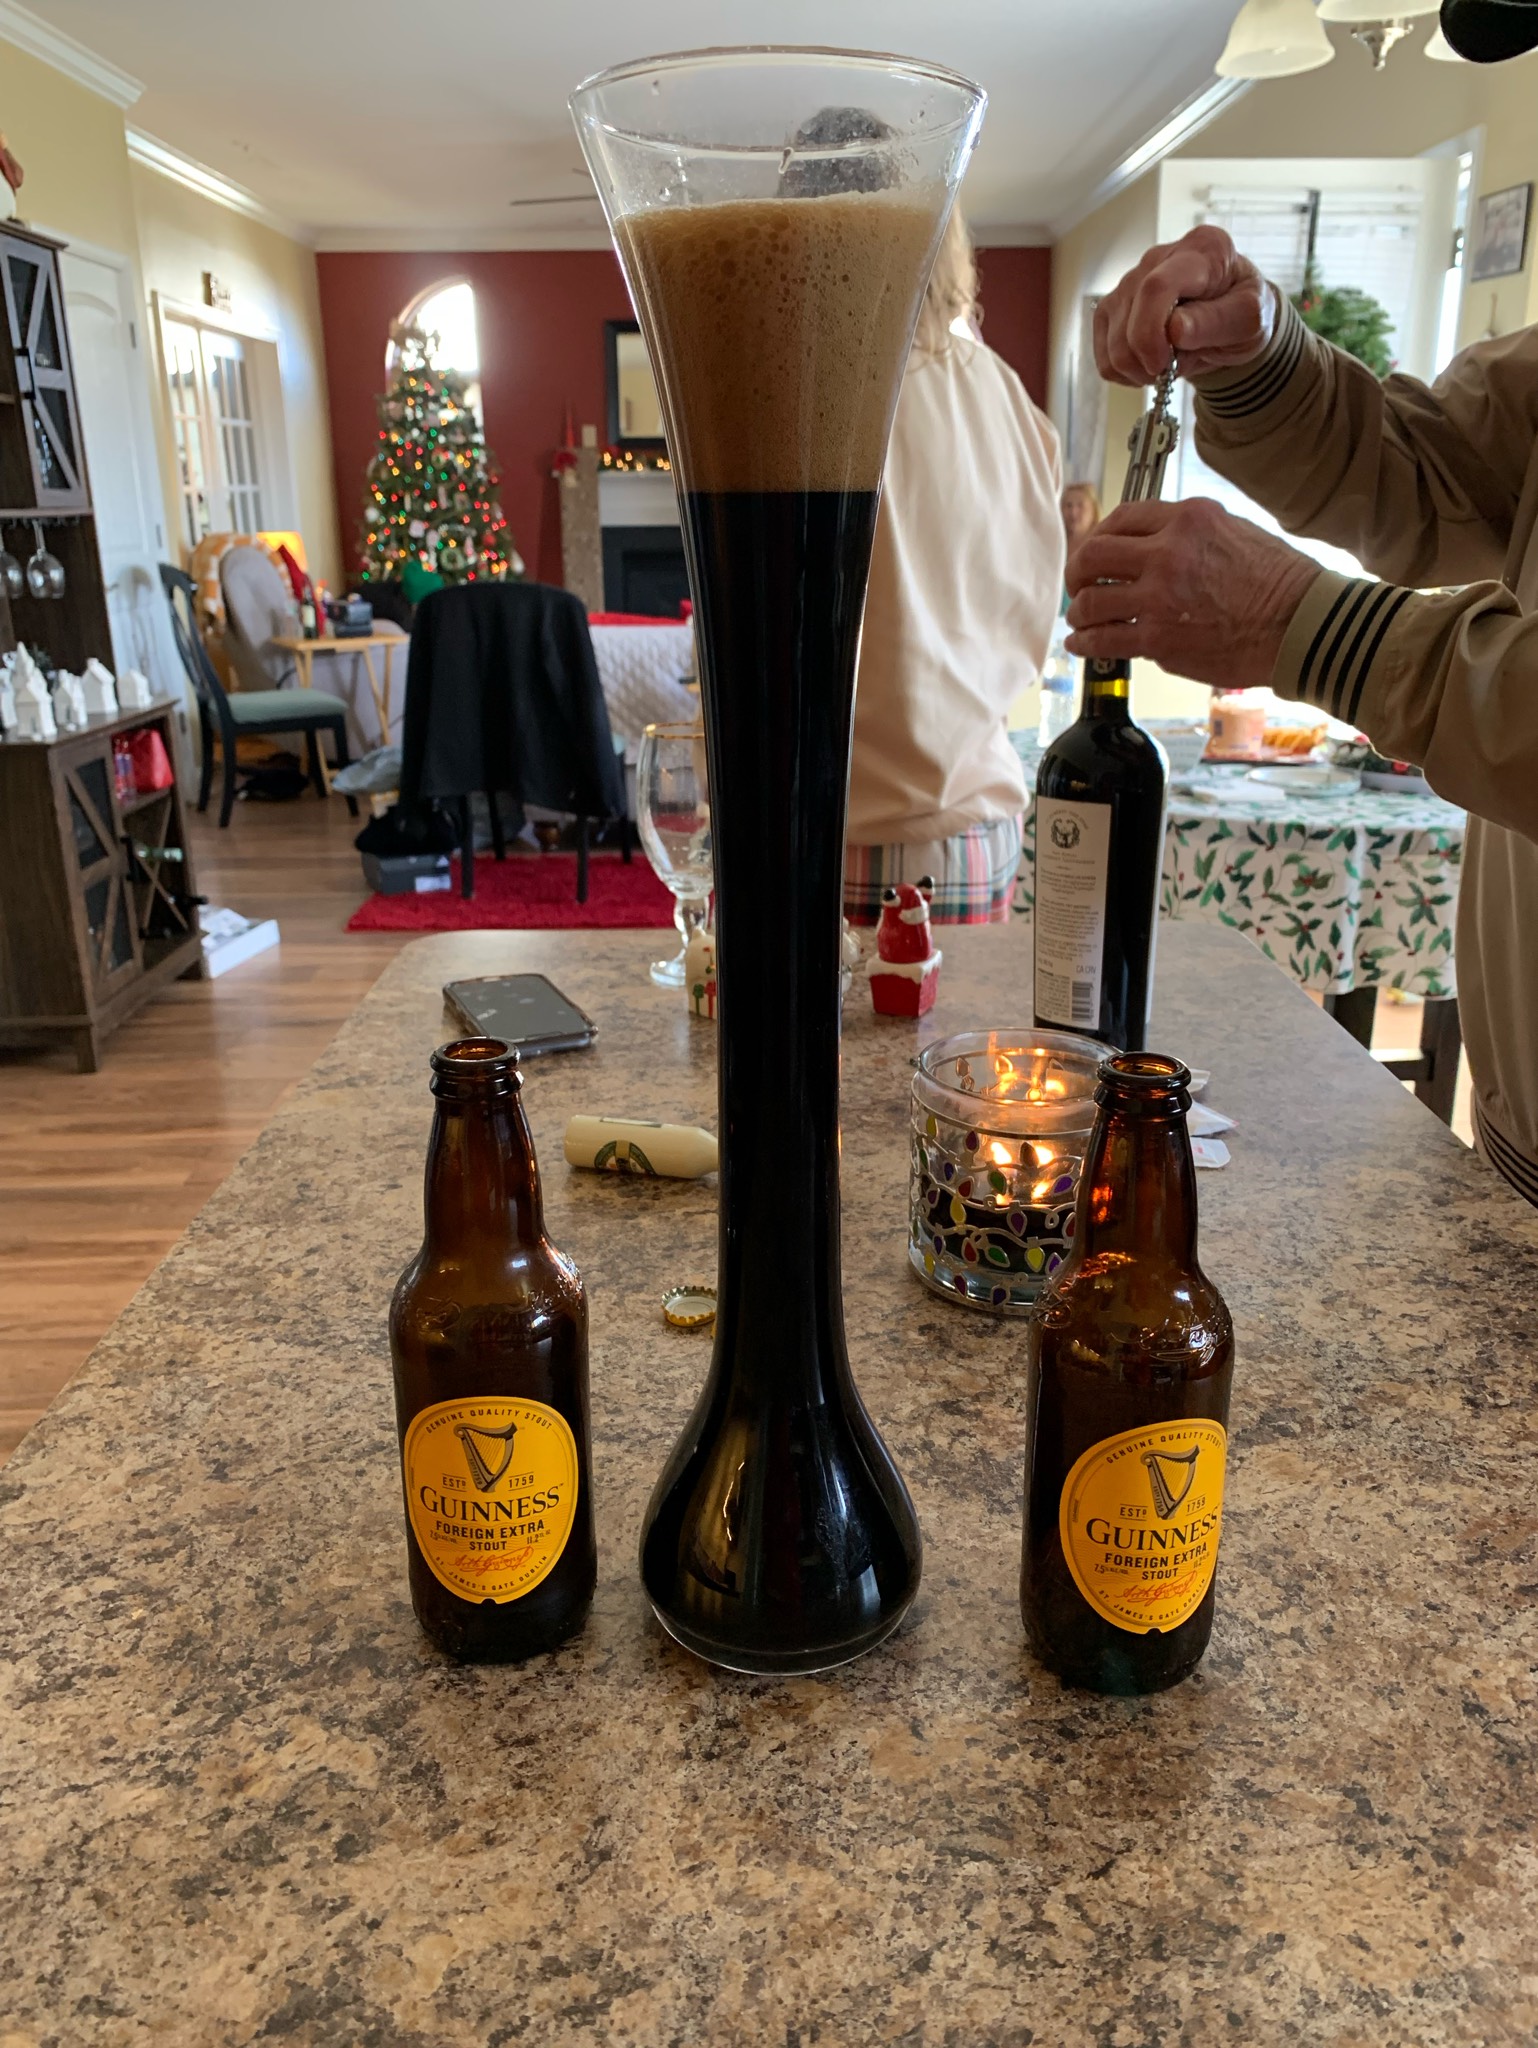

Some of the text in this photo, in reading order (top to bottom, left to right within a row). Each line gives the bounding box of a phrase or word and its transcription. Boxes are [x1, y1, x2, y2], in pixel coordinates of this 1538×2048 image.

[425, 1408, 552, 1434] GENUINE QUALITY STOUT
[1106, 1431, 1222, 1464] GENUINE QUALITY STOUT
[508, 1474, 534, 1488] 1759
[420, 1485, 560, 1522] GUINNESS
[1186, 1496, 1206, 1513] 1759
[436, 1520, 495, 1540] FOREIGN
[500, 1519, 545, 1538] EXTRA
[1086, 1506, 1219, 1551] GUINNESS
[469, 1541, 508, 1551] STOUT
[1104, 1552, 1169, 1569] FOREIGN
[1173, 1541, 1207, 1565] EXTRA
[448, 1571, 487, 1591] JAMES'S
[491, 1581, 515, 1591] GATE
[518, 1556, 548, 1582] DUBLIN
[1141, 1567, 1179, 1581] STOUT
[1113, 1603, 1154, 1621] JAMES'S
[1158, 1608, 1180, 1620] GATE
[1183, 1578, 1206, 1608] DUBLIN
